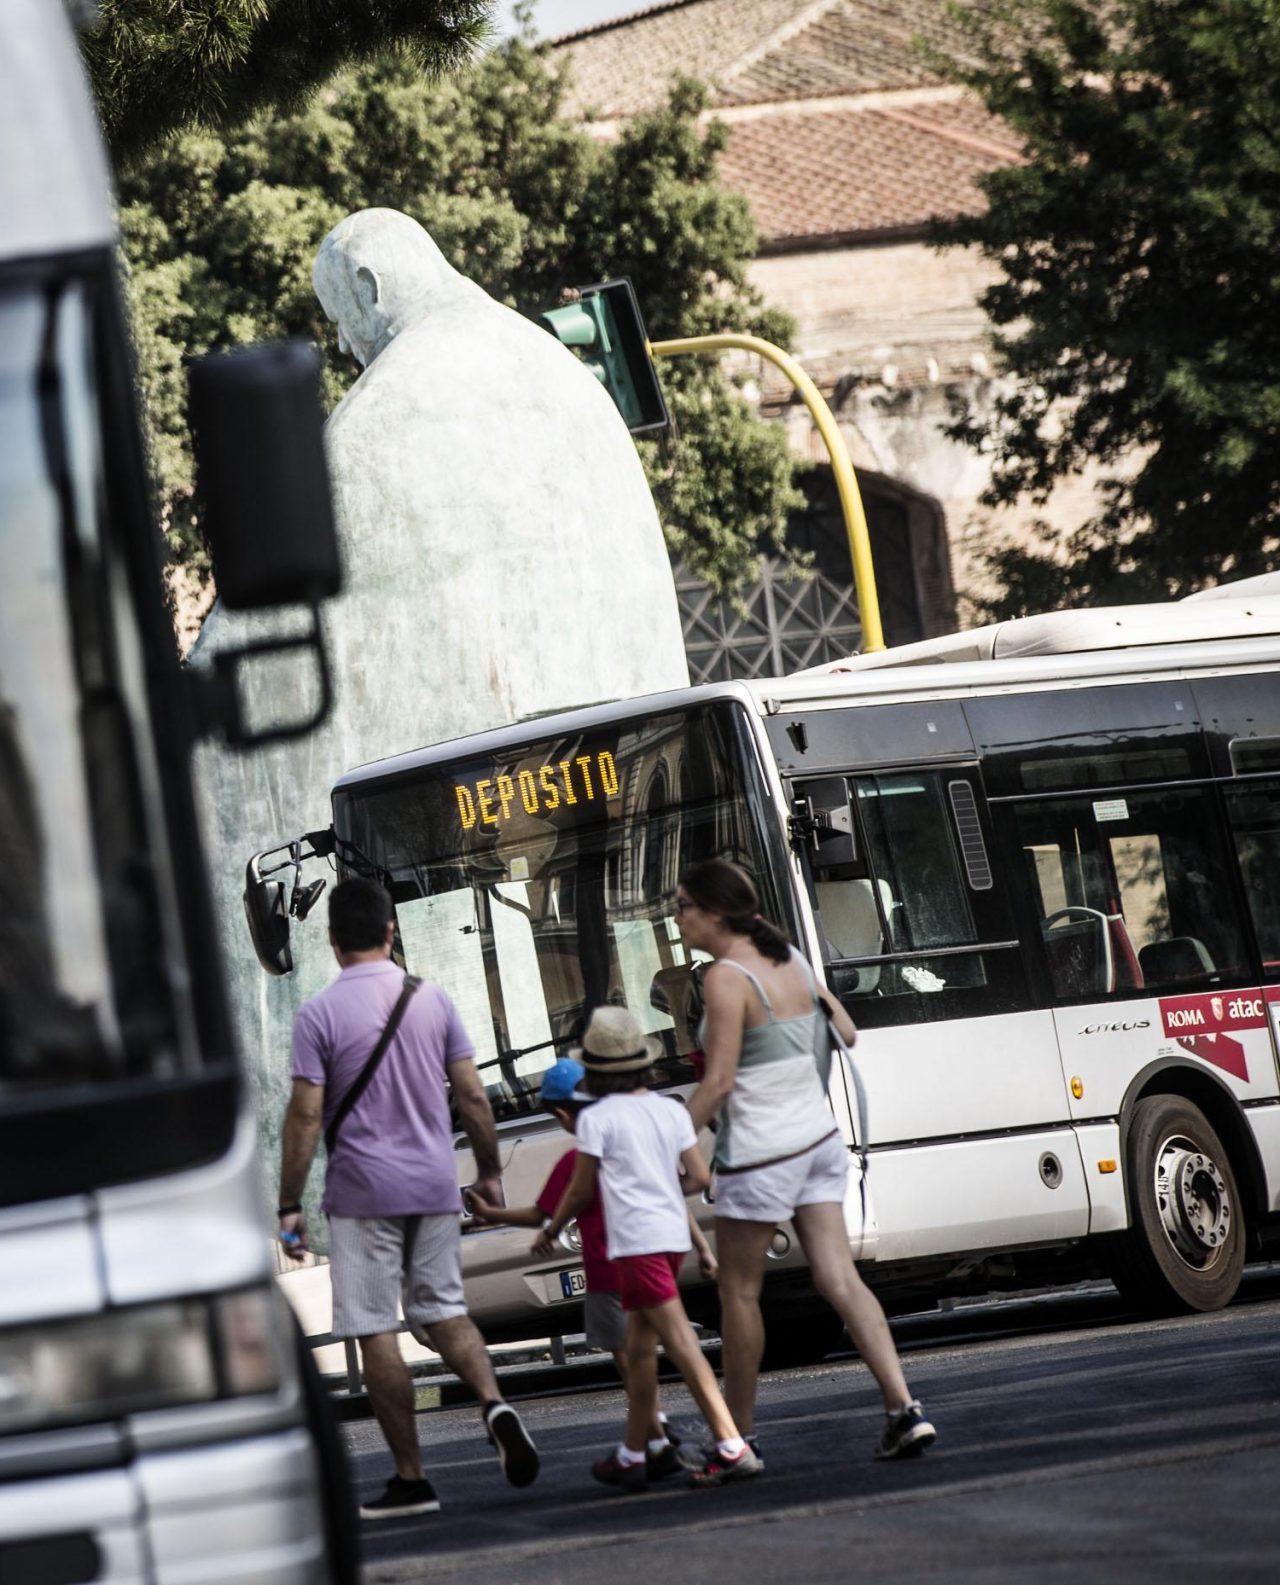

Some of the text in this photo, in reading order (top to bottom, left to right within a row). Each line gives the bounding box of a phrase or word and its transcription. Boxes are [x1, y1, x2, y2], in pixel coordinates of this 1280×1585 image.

[454, 750, 619, 830] DEPOSITO
[1166, 997, 1265, 1029] ROMA atac
